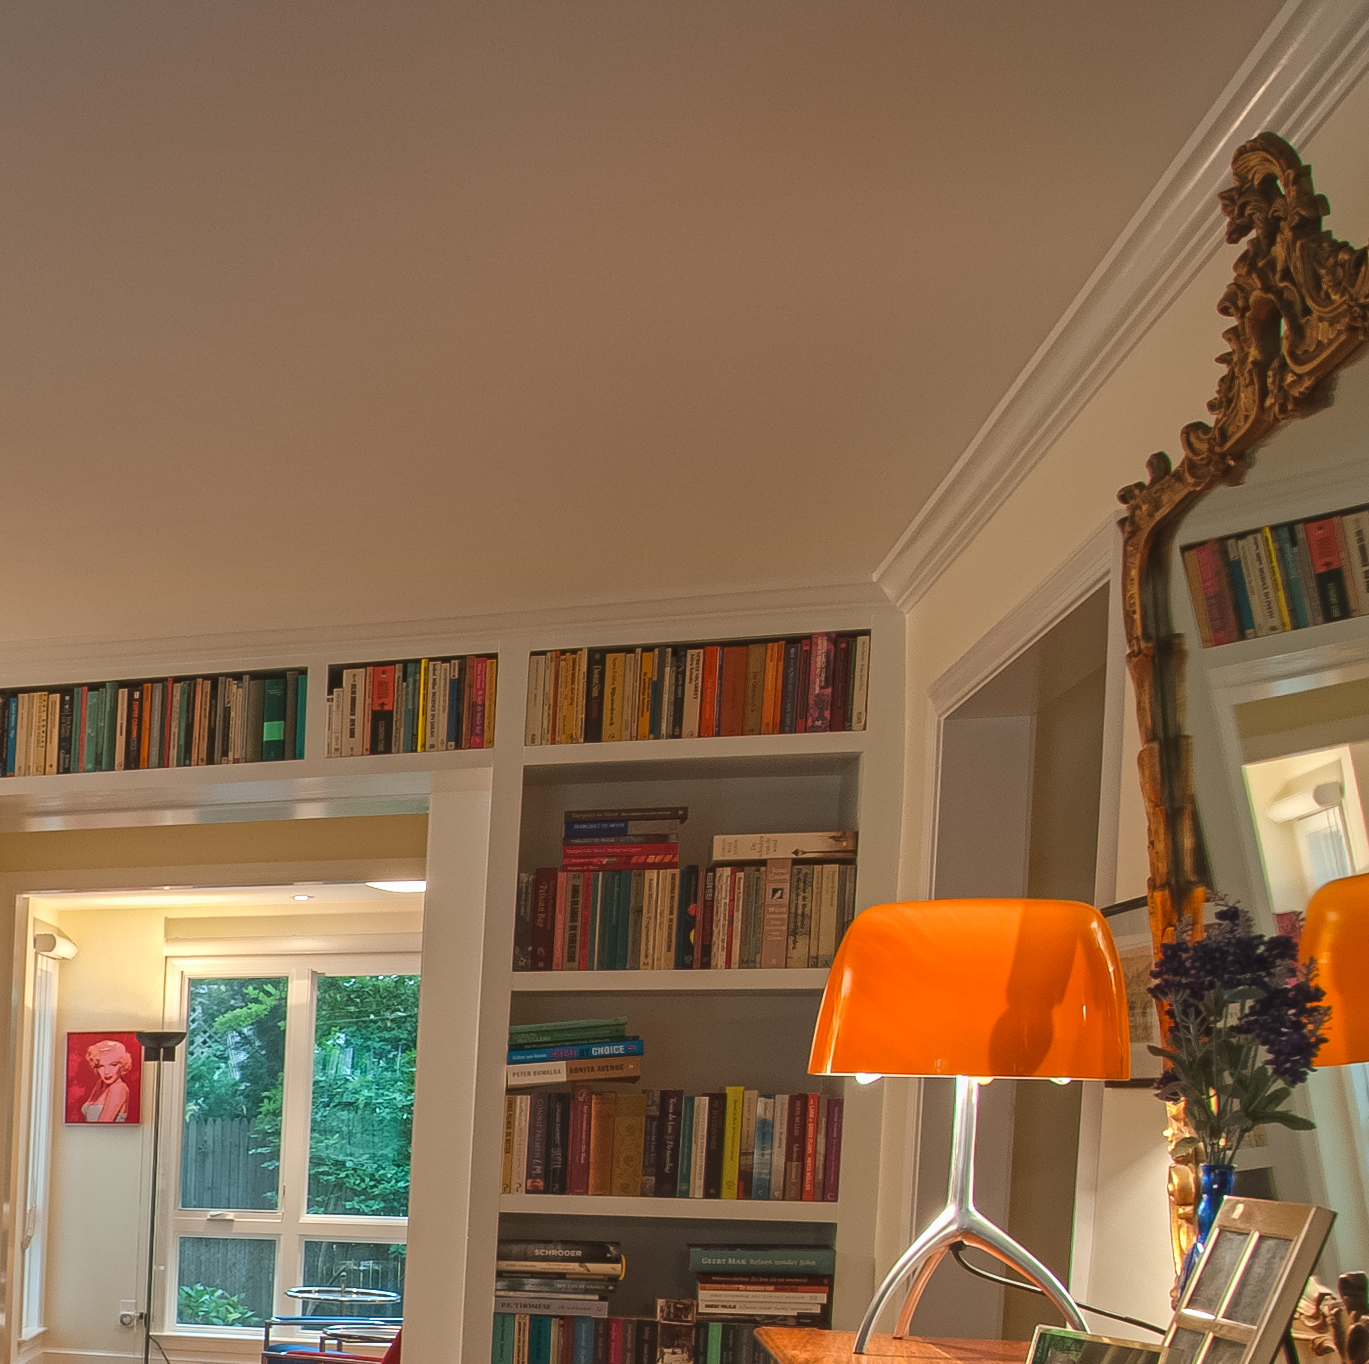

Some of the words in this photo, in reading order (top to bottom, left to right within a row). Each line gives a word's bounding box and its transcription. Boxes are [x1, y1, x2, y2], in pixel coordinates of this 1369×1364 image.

[592, 1045, 625, 1056] CHOICE
[513, 1070, 532, 1078] PETER
[569, 1065, 595, 1074] BONITA
[597, 1063, 624, 1073] AVENUE
[534, 1249, 583, 1257] SCHRODER
